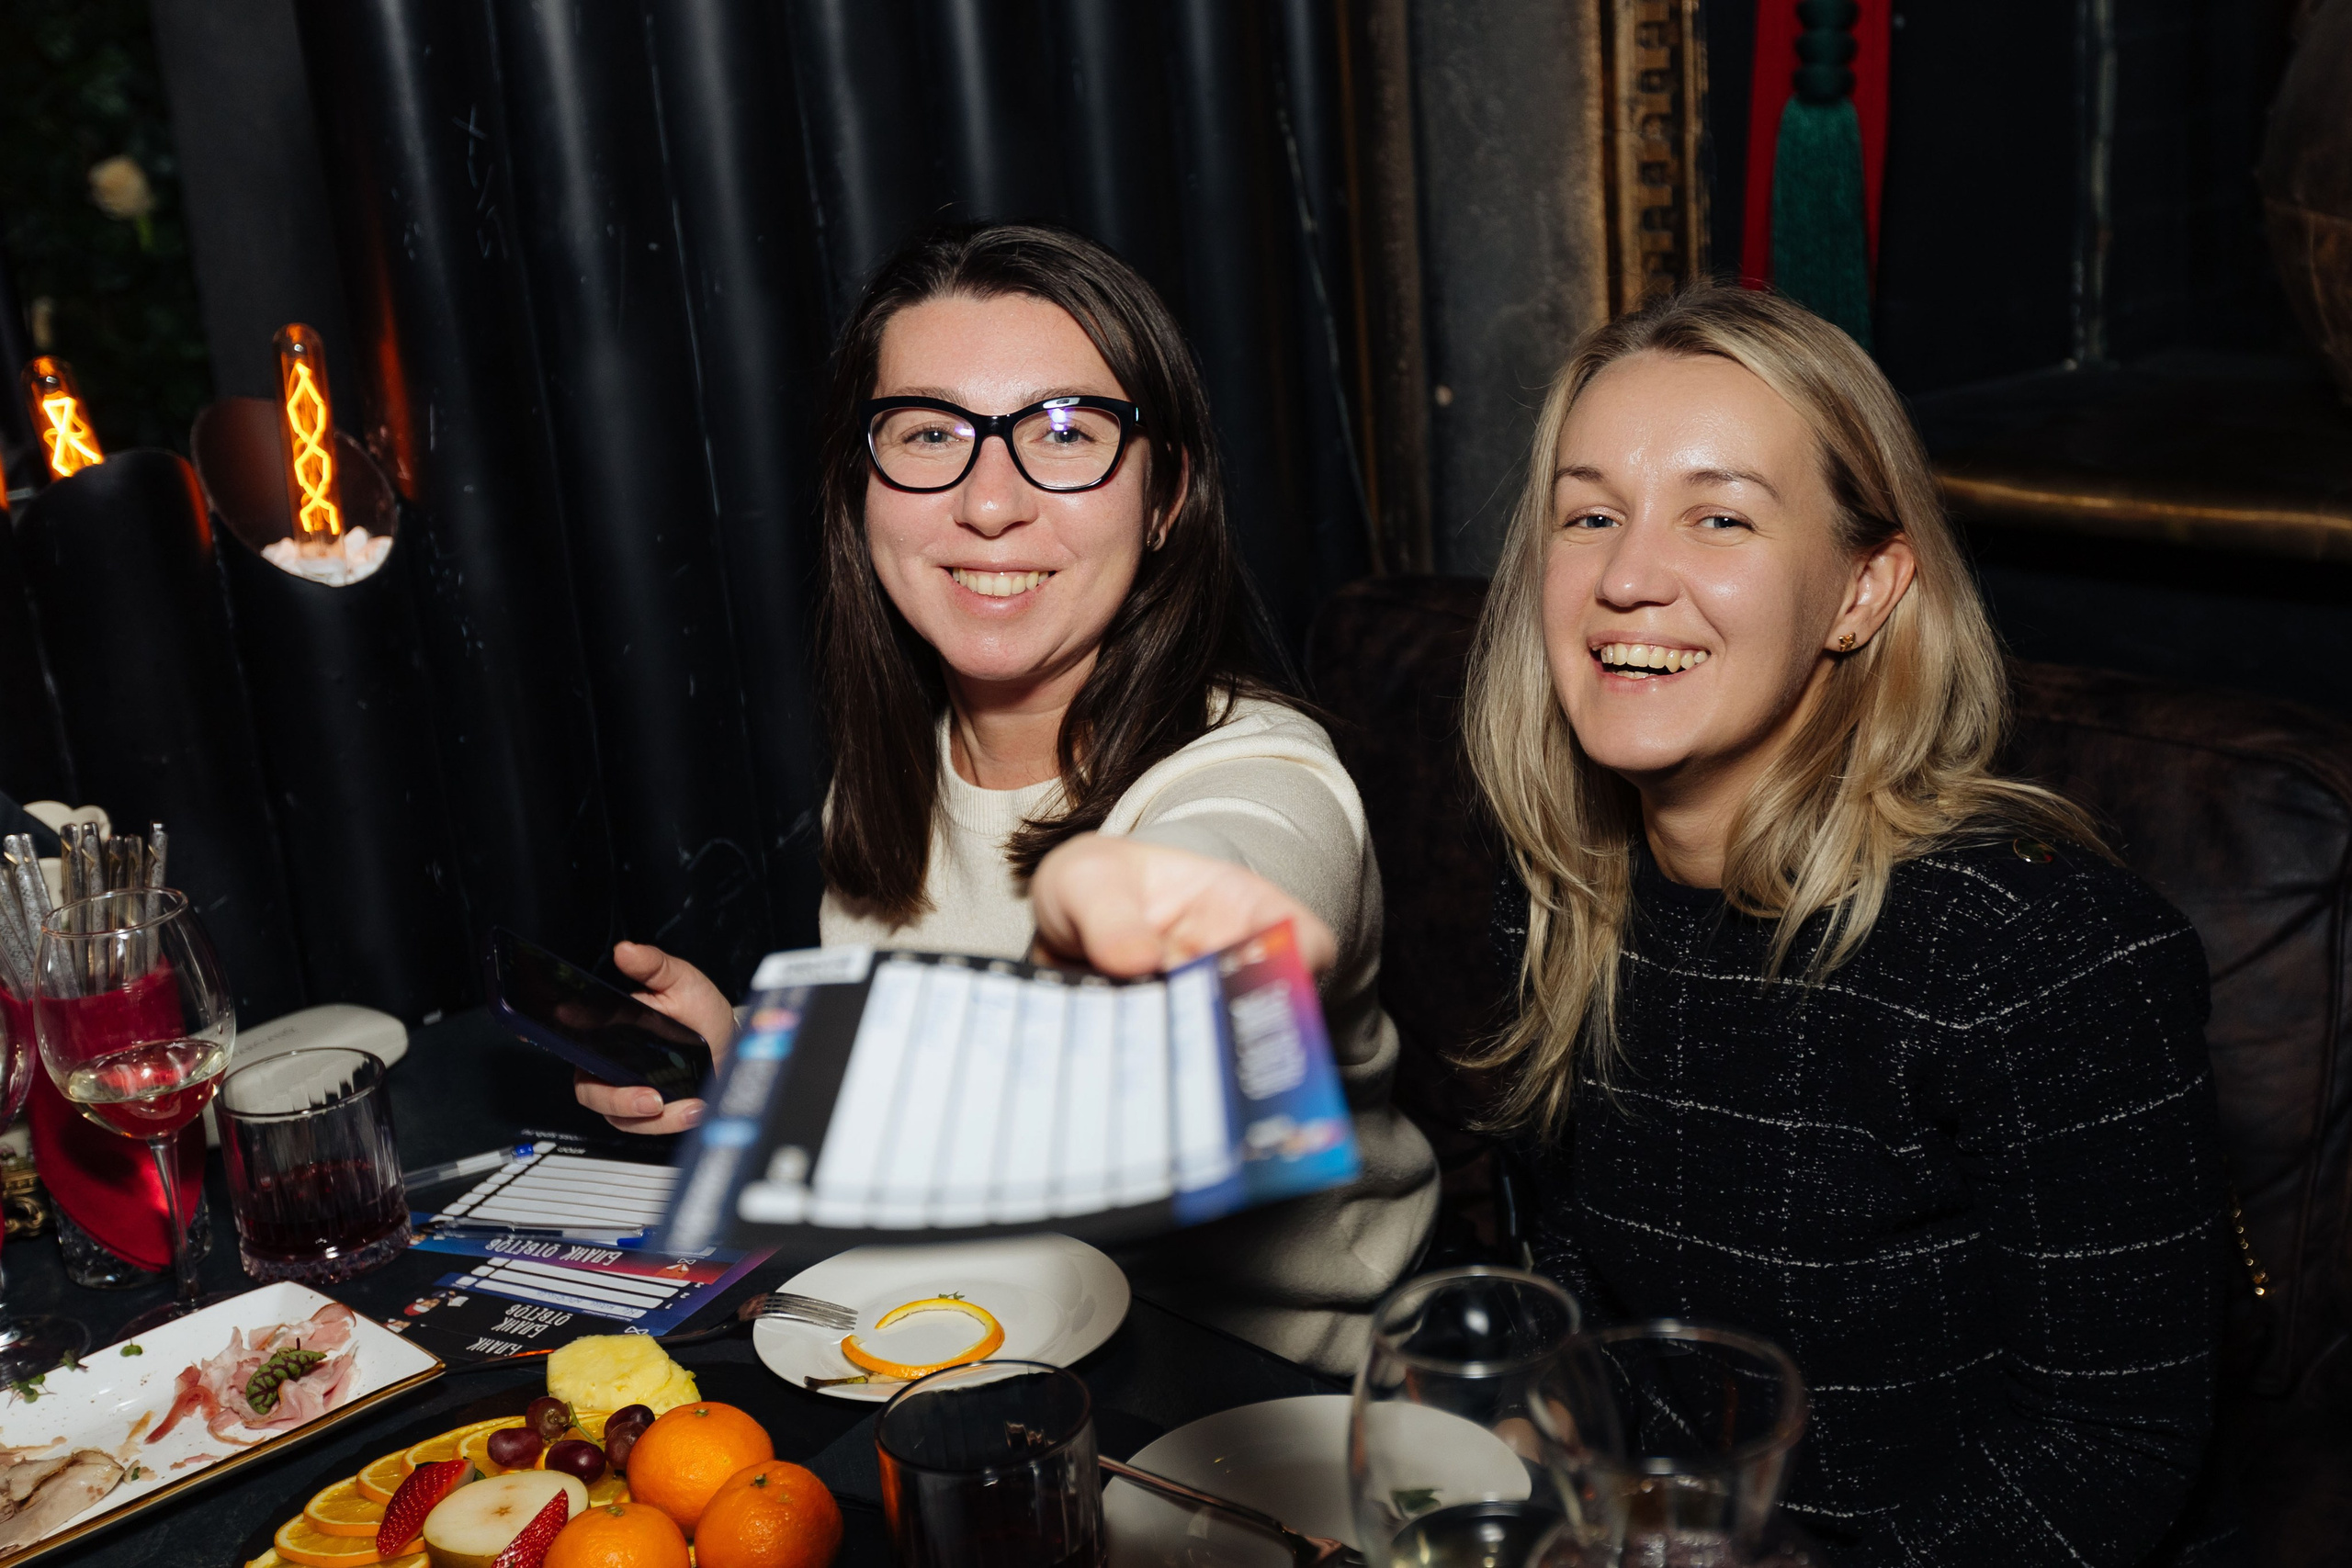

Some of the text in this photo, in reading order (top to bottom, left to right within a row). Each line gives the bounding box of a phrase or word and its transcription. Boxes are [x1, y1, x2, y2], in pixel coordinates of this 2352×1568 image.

[485, 1238, 623, 1266] БЛАНК ОТВЕТОВ
[505, 1303, 573, 1326] ОТВЕТОВ
[491, 1316, 549, 1338] БЛАНК
